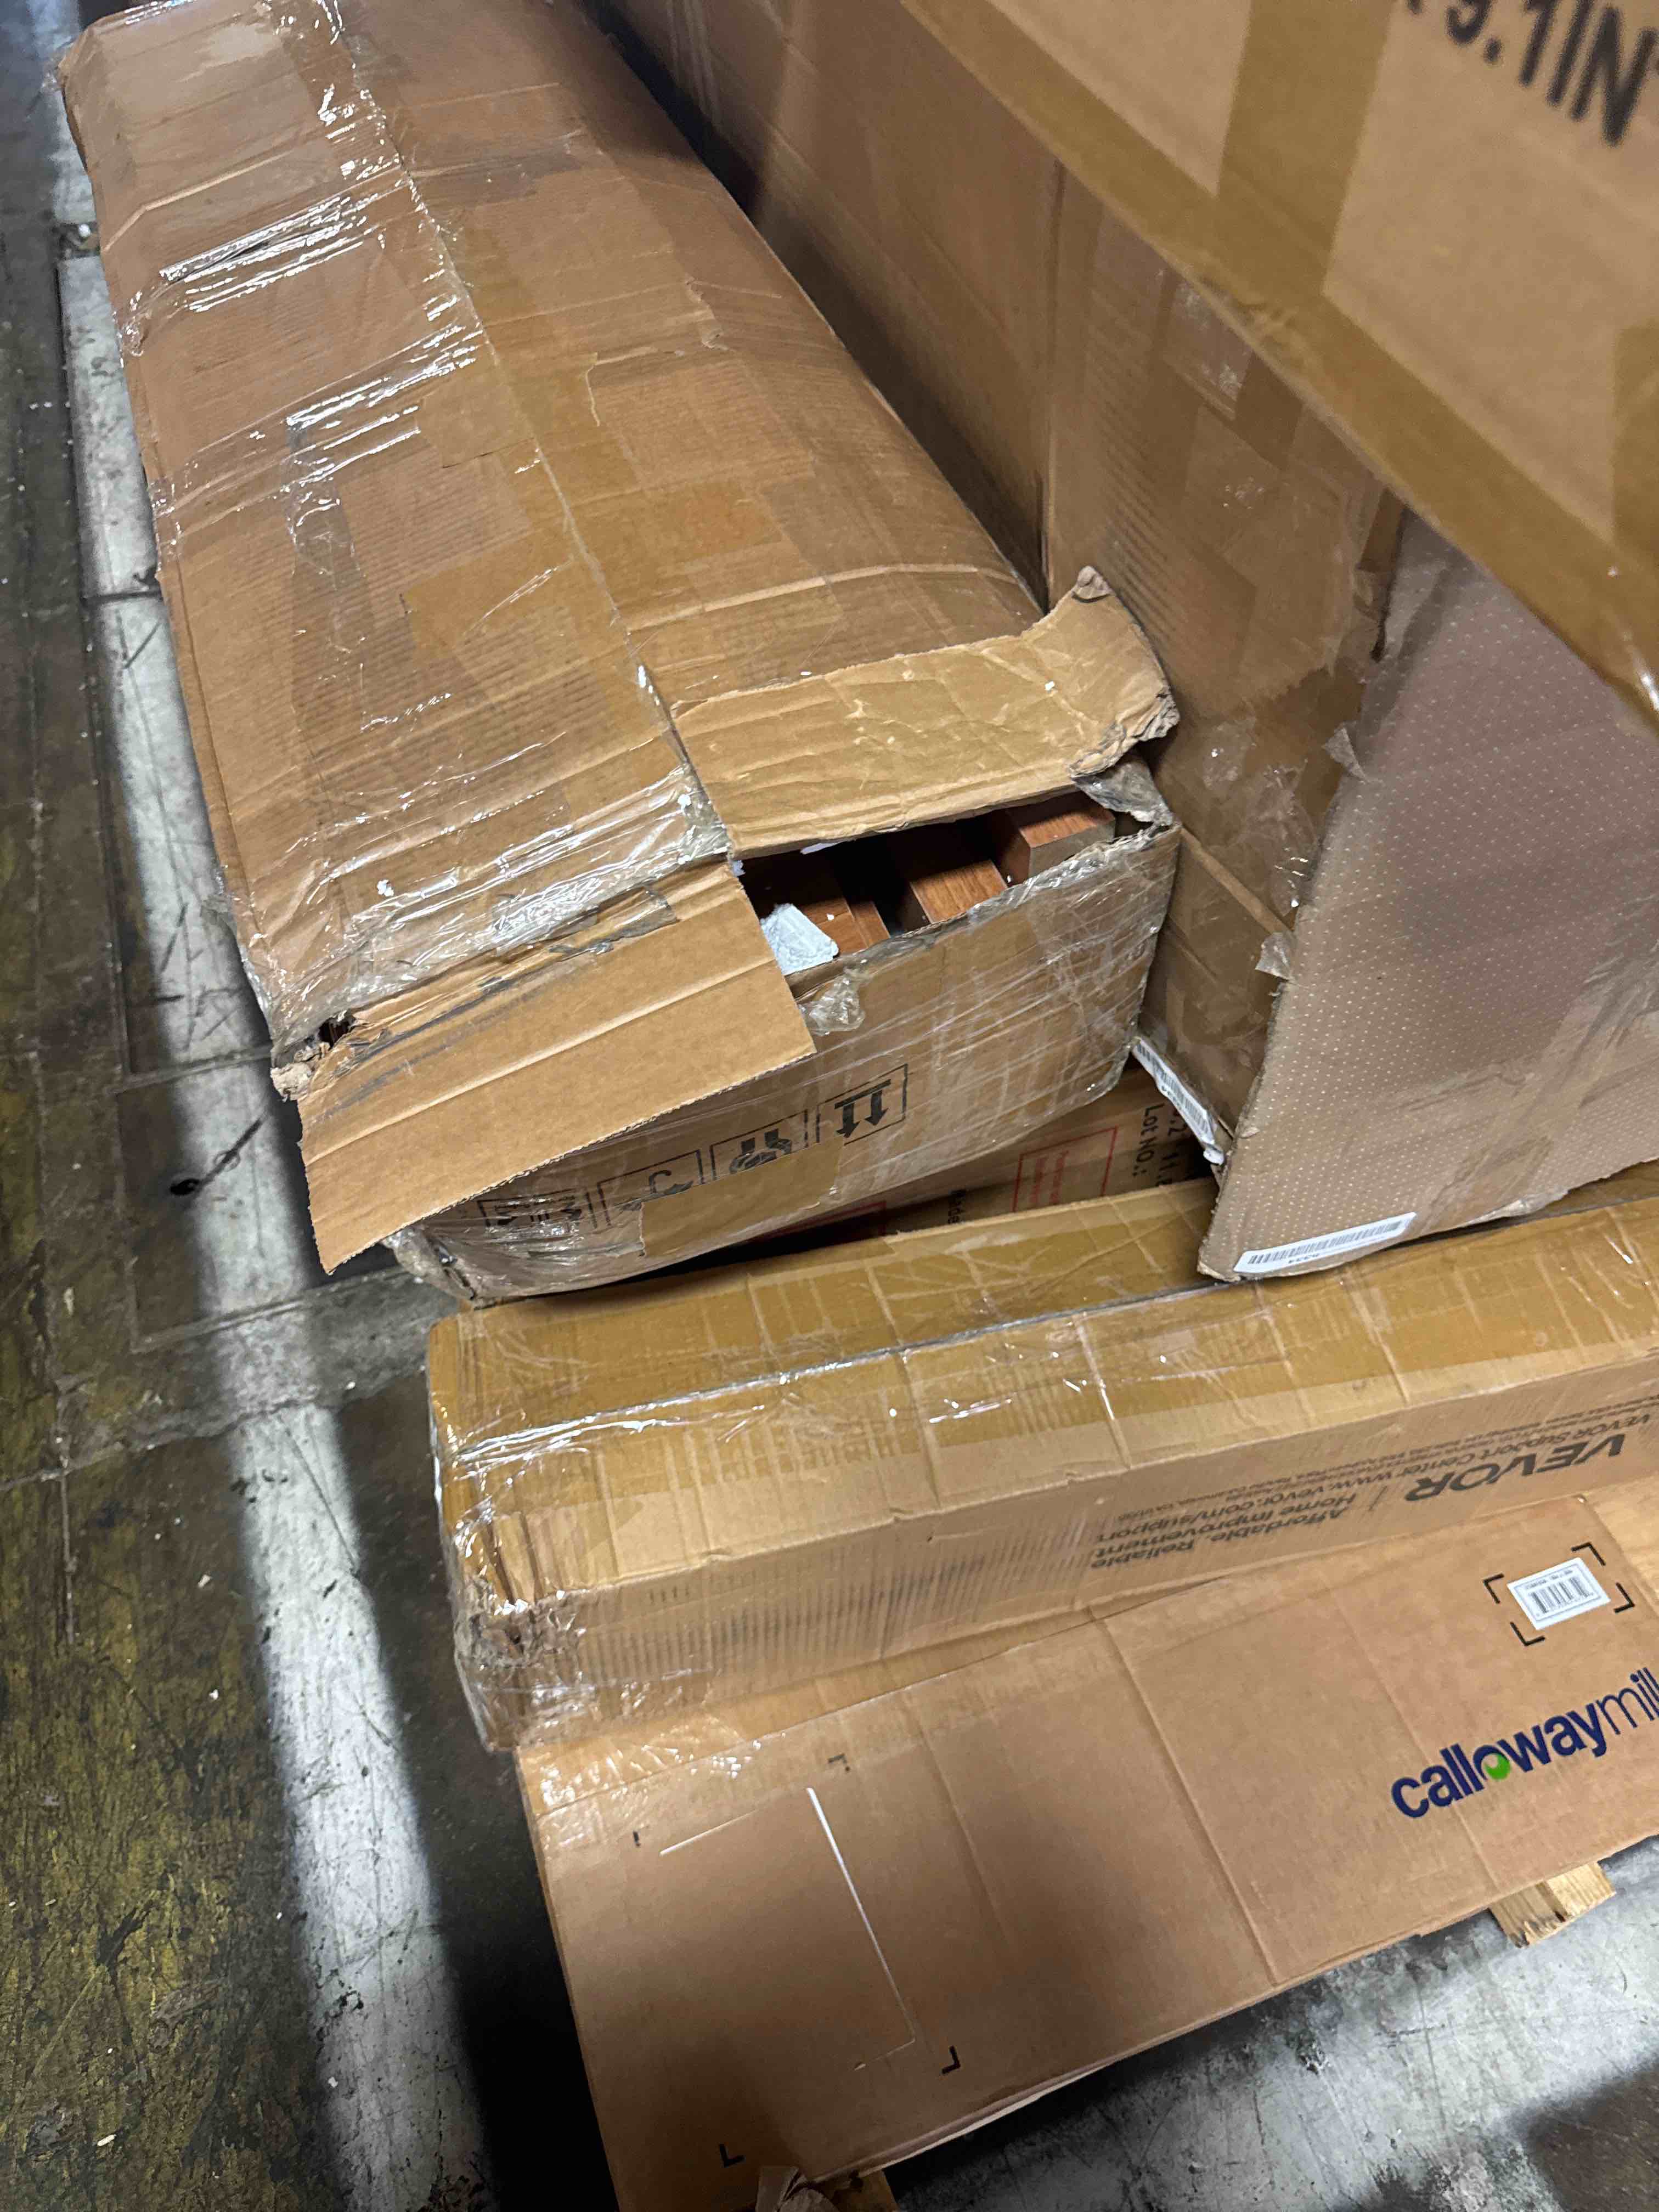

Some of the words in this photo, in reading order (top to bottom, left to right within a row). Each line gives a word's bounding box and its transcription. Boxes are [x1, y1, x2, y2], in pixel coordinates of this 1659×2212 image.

[1480, 1431, 1571, 1461] Support
[1396, 1452, 1476, 1477] Center
[1404, 1434, 1626, 1502] VEVOR
[1279, 1493, 1357, 1515] Home
[1095, 1510, 1274, 1559] Improvement
[1090, 1538, 1194, 1570] Reliable
